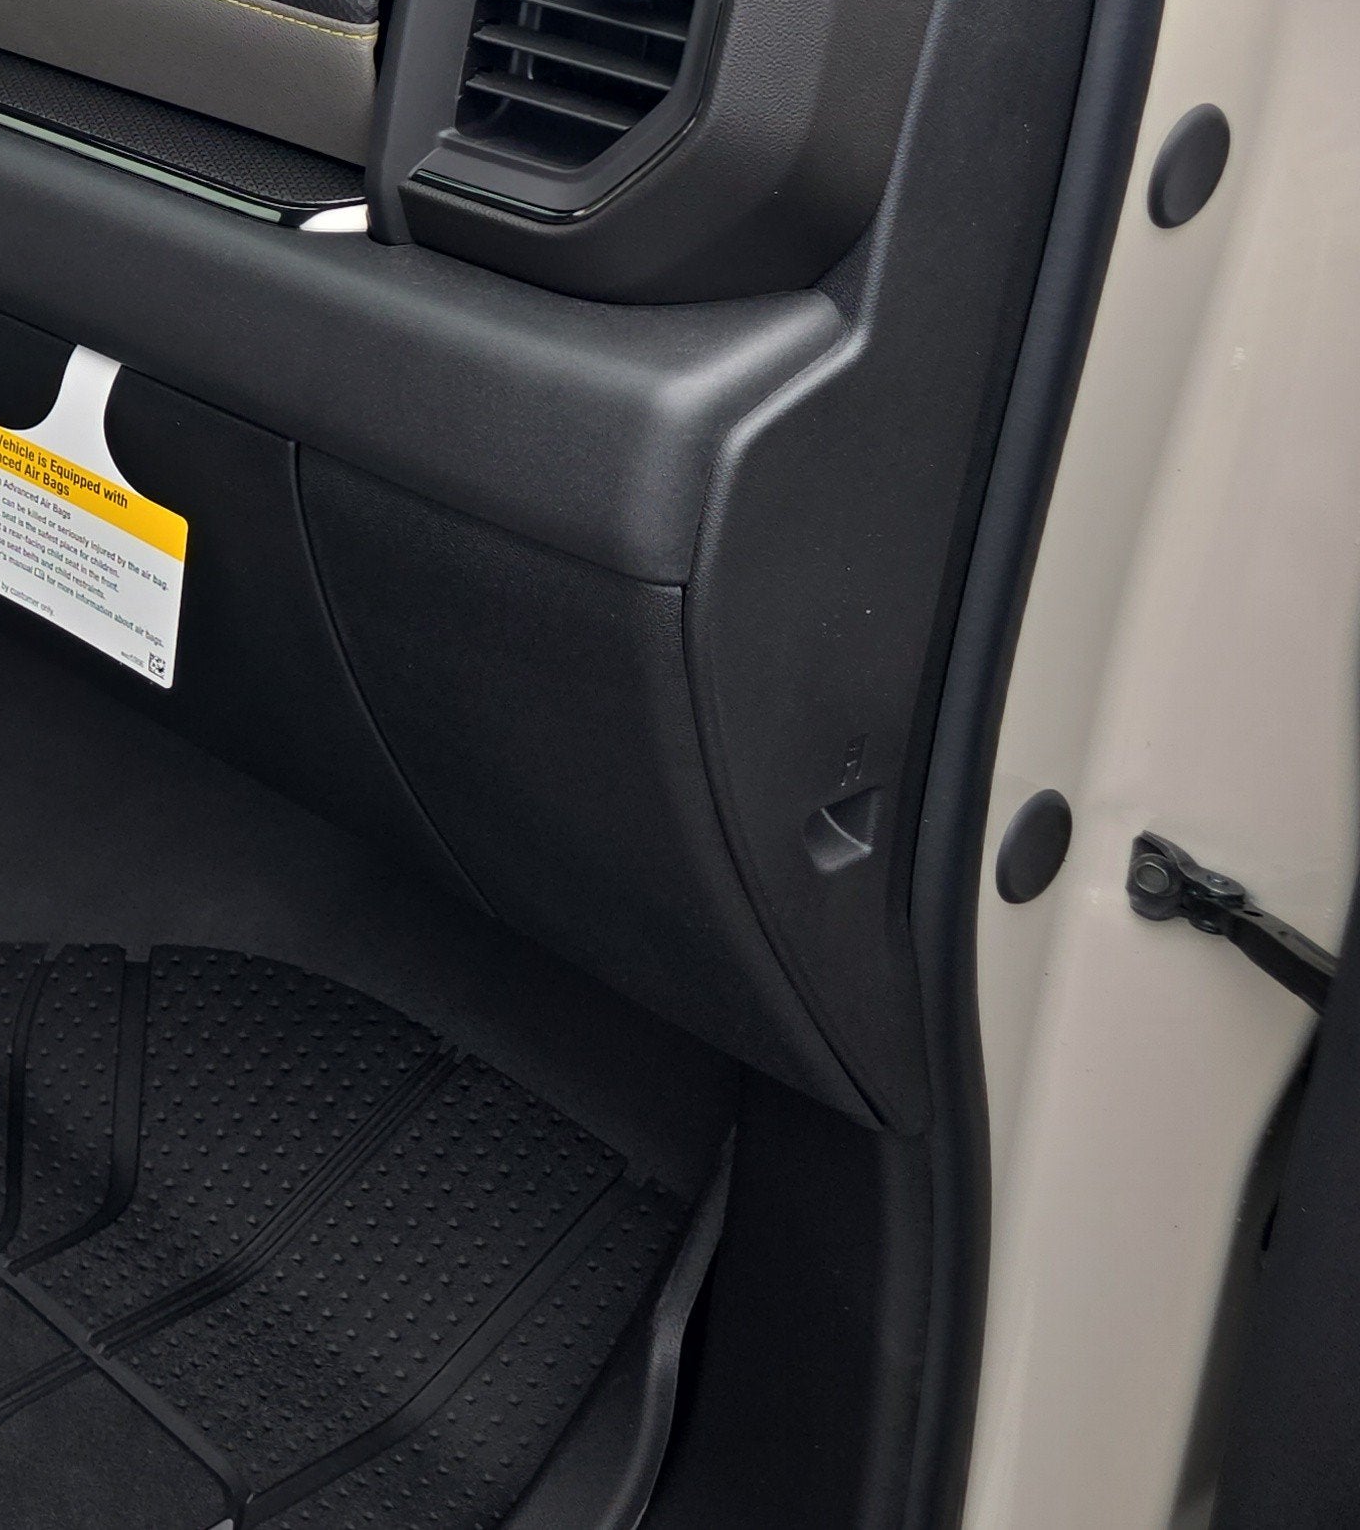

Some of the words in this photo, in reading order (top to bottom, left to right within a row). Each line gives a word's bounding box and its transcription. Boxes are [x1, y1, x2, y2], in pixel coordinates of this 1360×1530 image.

[3, 477, 38, 504] Advanced
[40, 496, 51, 510] Air
[52, 502, 71, 522] Bags
[24, 462, 40, 481] Air
[42, 471, 70, 499] Bags
[37, 452, 47, 468] is
[49, 458, 100, 497] Equipped
[102, 484, 128, 509] with
[2, 496, 14, 508] can
[16, 502, 25, 514] be
[27, 507, 46, 524] killed
[48, 519, 55, 529] or
[56, 523, 89, 548] seriously
[90, 540, 115, 562] injured
[117, 554, 126, 568] by
[127, 561, 139, 574] the
[141, 567, 151, 580] air
